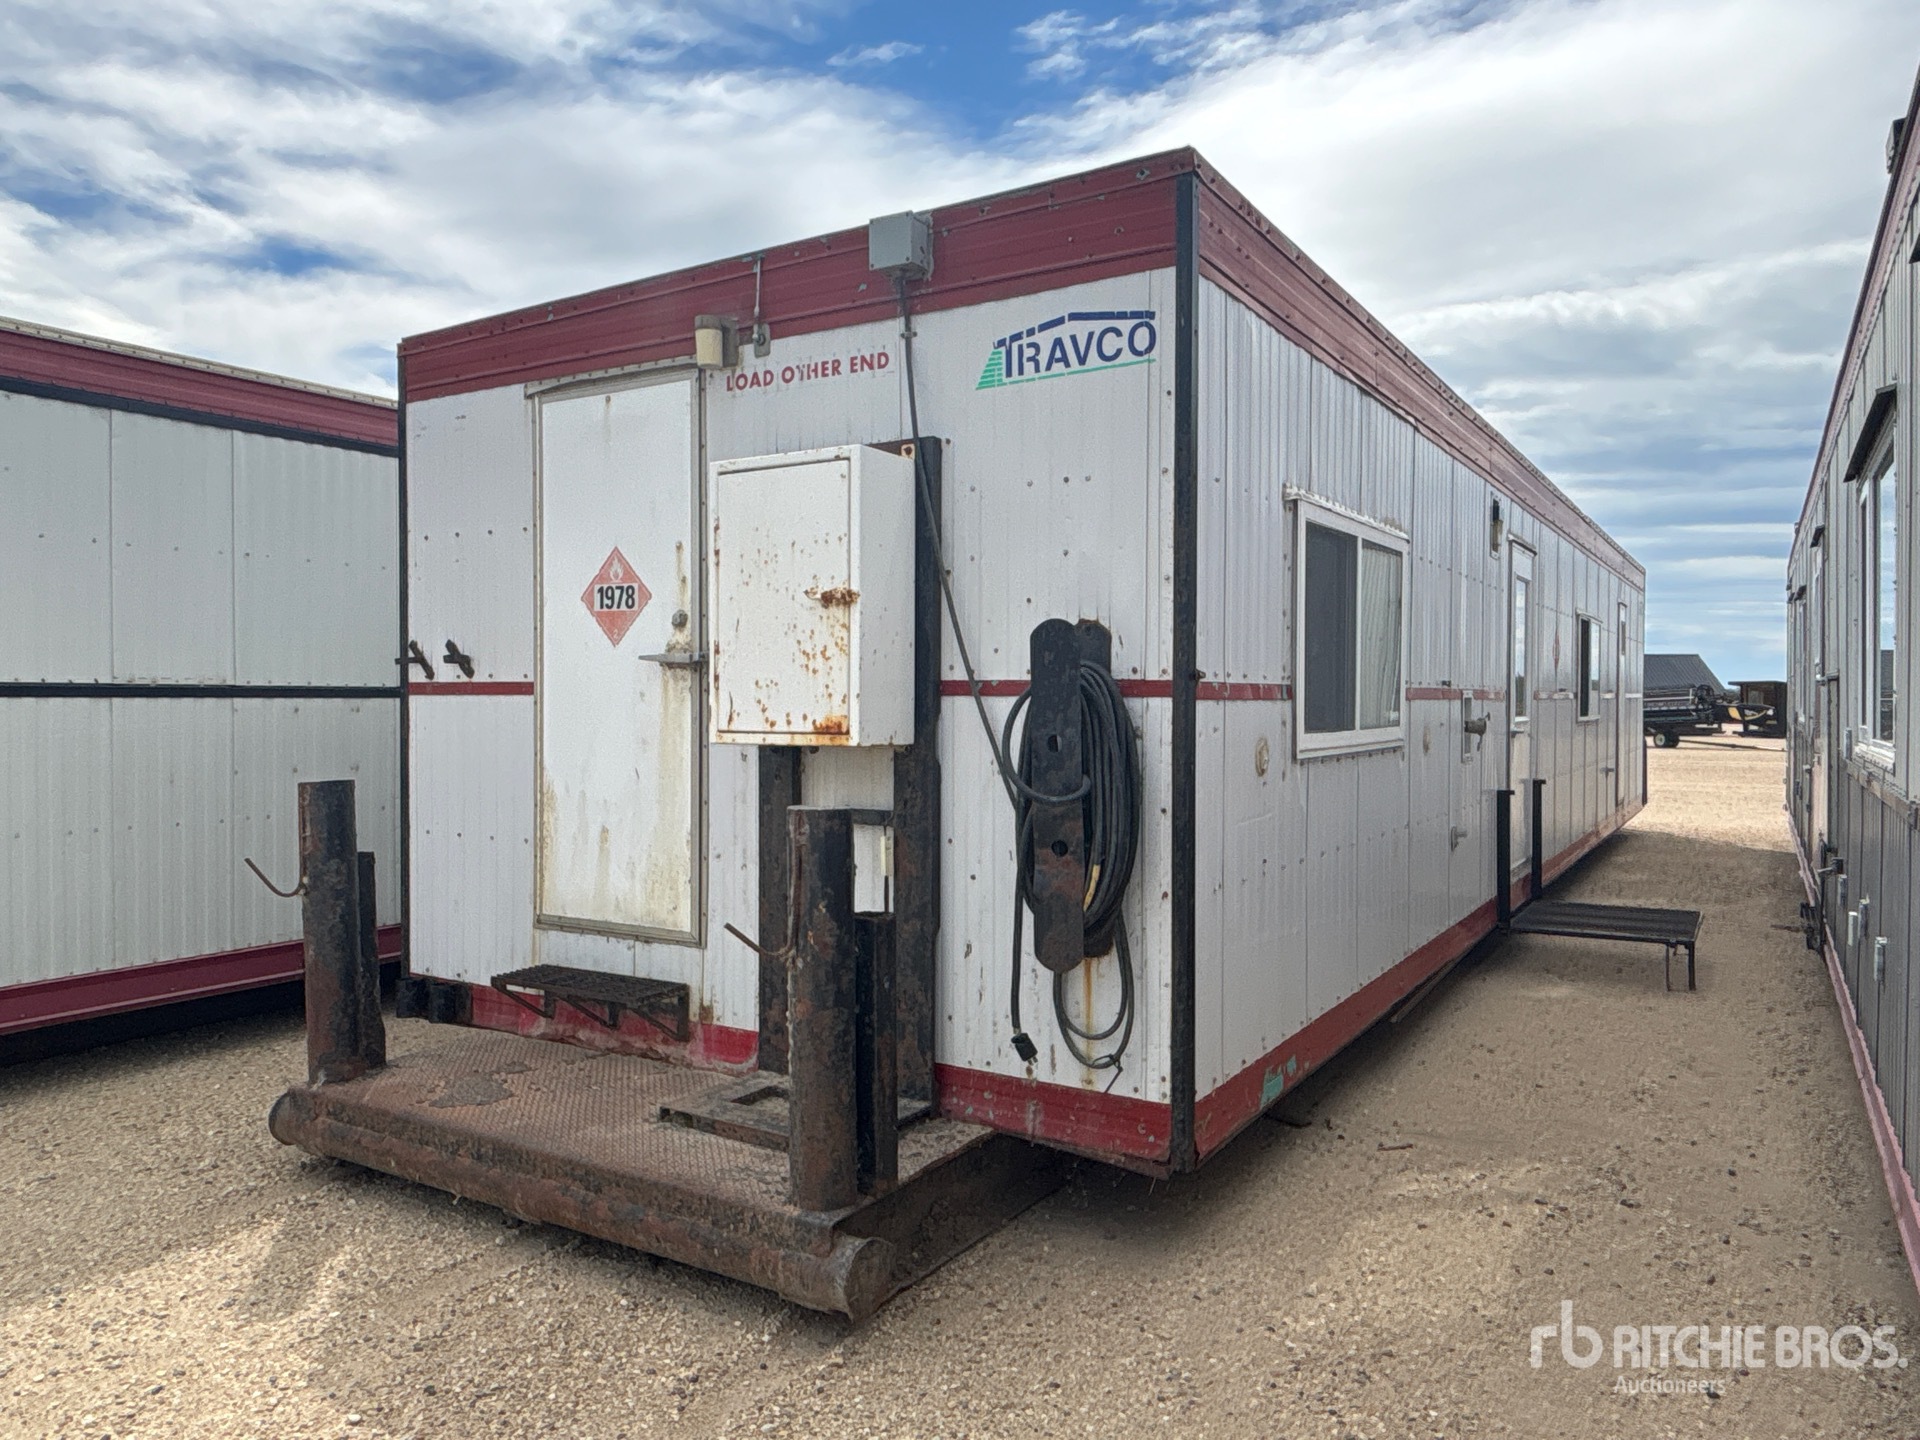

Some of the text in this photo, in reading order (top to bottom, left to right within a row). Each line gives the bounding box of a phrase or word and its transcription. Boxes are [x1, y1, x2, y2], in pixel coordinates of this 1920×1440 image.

[994, 312, 1156, 378] TRAVCO
[726, 352, 889, 391] LOAD OTHER END
[597, 585, 635, 610] 1978
